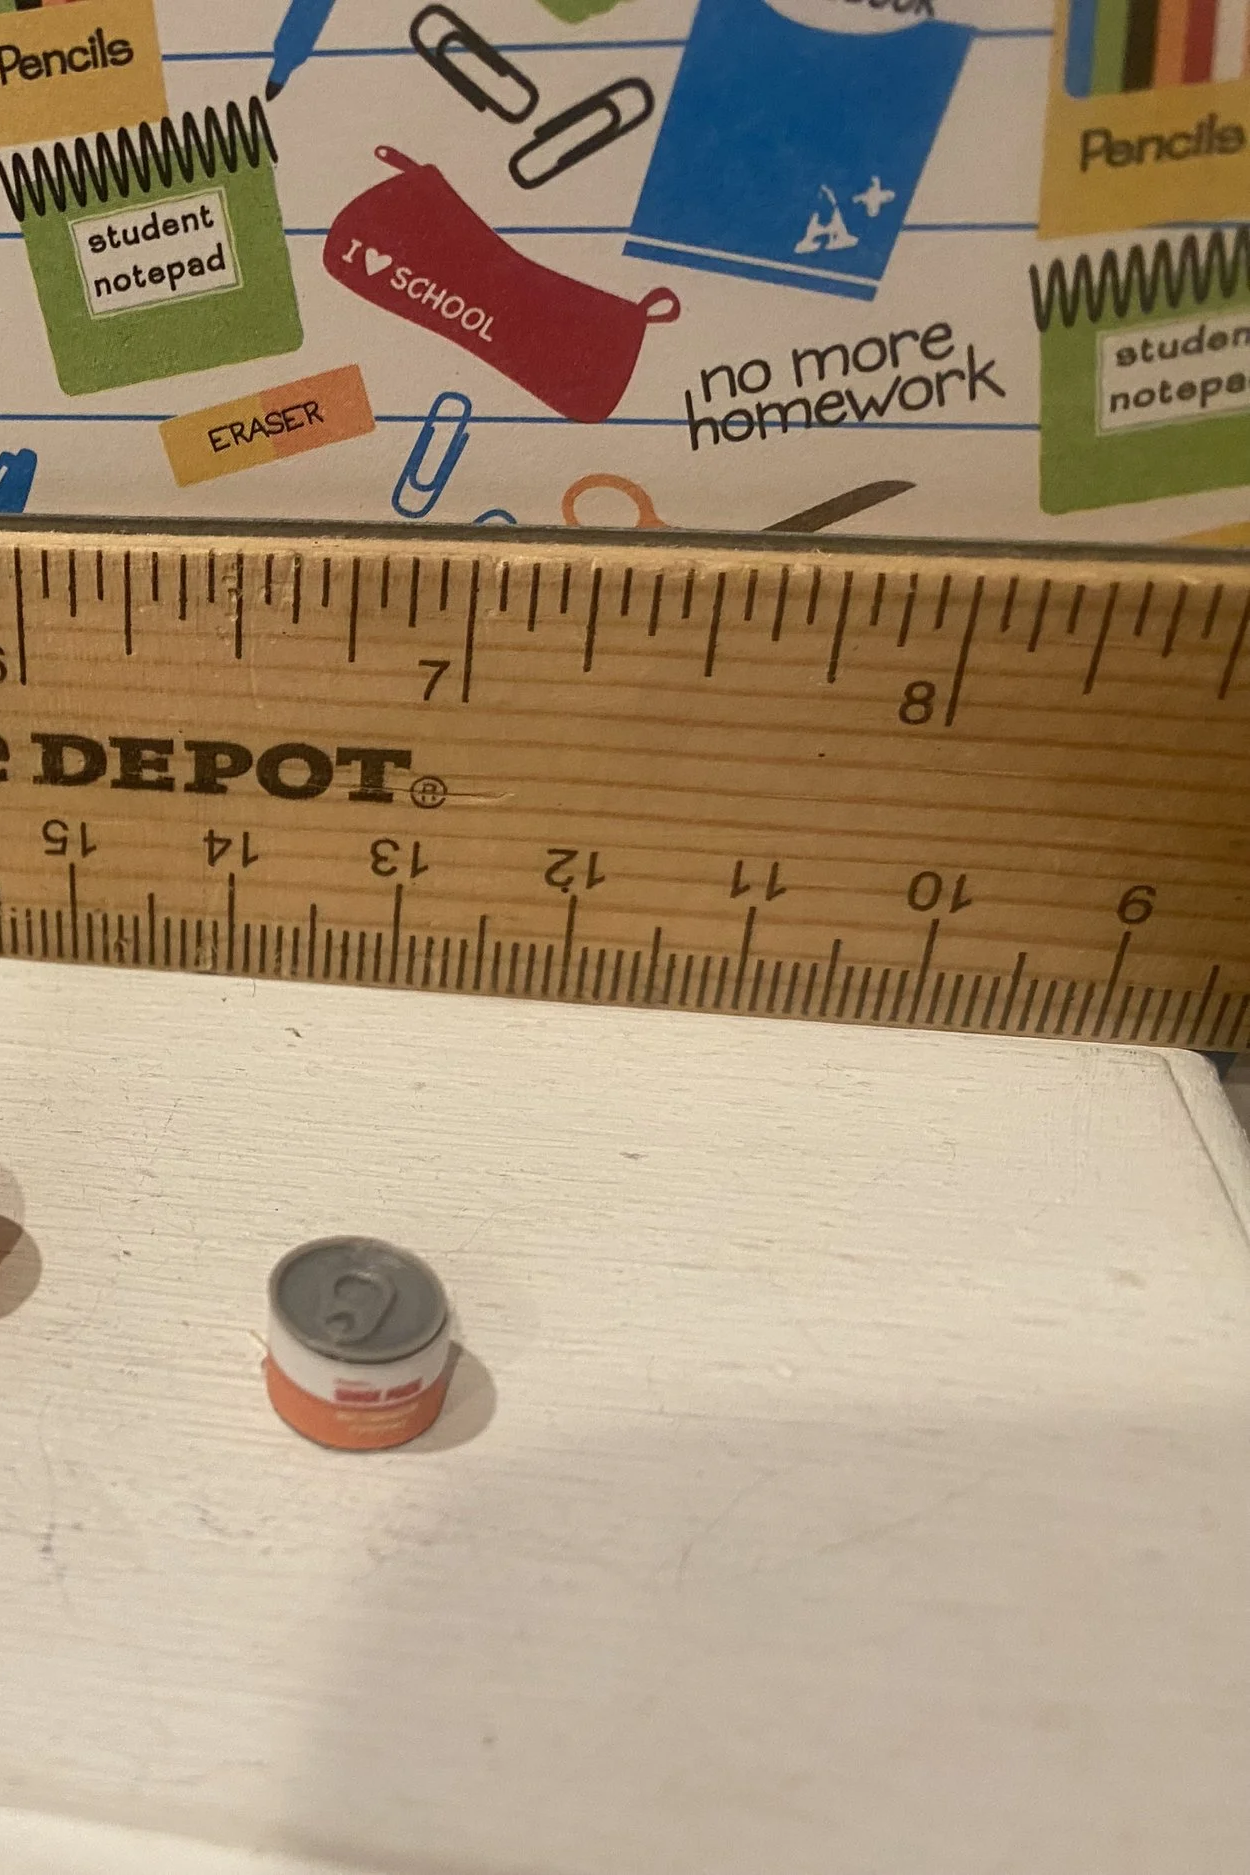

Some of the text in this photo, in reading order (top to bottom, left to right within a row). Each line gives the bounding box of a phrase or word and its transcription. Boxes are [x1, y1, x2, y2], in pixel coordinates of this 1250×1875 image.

[1079, 112, 1248, 173] Pencils
[88, 204, 214, 252] student
[94, 244, 225, 298] notepad
[340, 238, 497, 343] I SCHOOL
[699, 320, 956, 403] no more
[1115, 323, 1250, 368] studen
[683, 343, 1007, 451] homework
[1109, 371, 1250, 414] notepa
[206, 399, 325, 453] ERASER
[417, 659, 450, 701] 7
[898, 680, 936, 726] 8
[30, 732, 413, 803] DEPOT
[41, 818, 98, 858] 15
[202, 828, 260, 868] 14
[369, 837, 430, 879] 13
[543, 847, 606, 889] 12
[729, 859, 788, 900] 11
[906, 870, 973, 914] 10
[1116, 884, 1157, 925] 9
